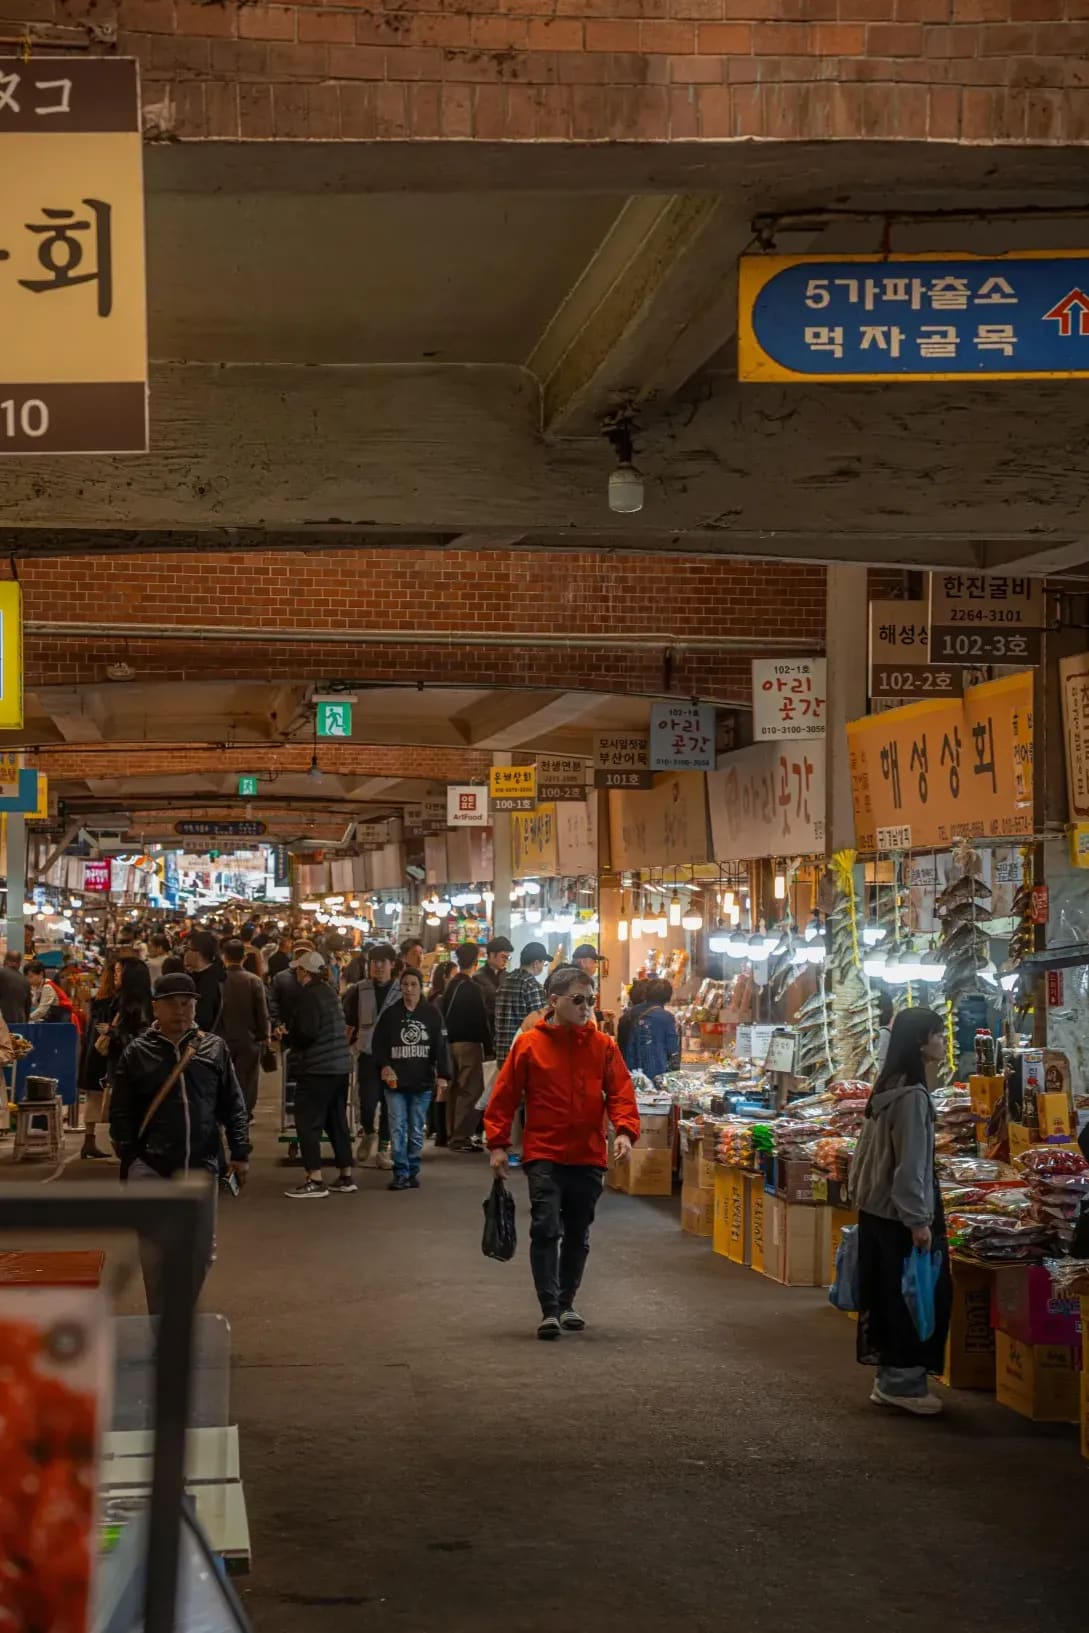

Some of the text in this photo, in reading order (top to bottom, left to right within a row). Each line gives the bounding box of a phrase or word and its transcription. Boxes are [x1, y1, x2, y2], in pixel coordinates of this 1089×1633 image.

[0, 198, 112, 318] 회
[943, 575, 1032, 600] 한진굴비
[950, 609, 1022, 622] 2264-3101
[942, 634, 1029, 656] 102-3호
[774, 665, 810, 675] 102-1호
[762, 677, 812, 693] 아리
[879, 672, 952, 690] 102-2호
[658, 719, 700, 732] 아리
[880, 716, 997, 809] 해성상회
[606, 773, 640, 785] 101호
[495, 799, 532, 809] 100-1호
